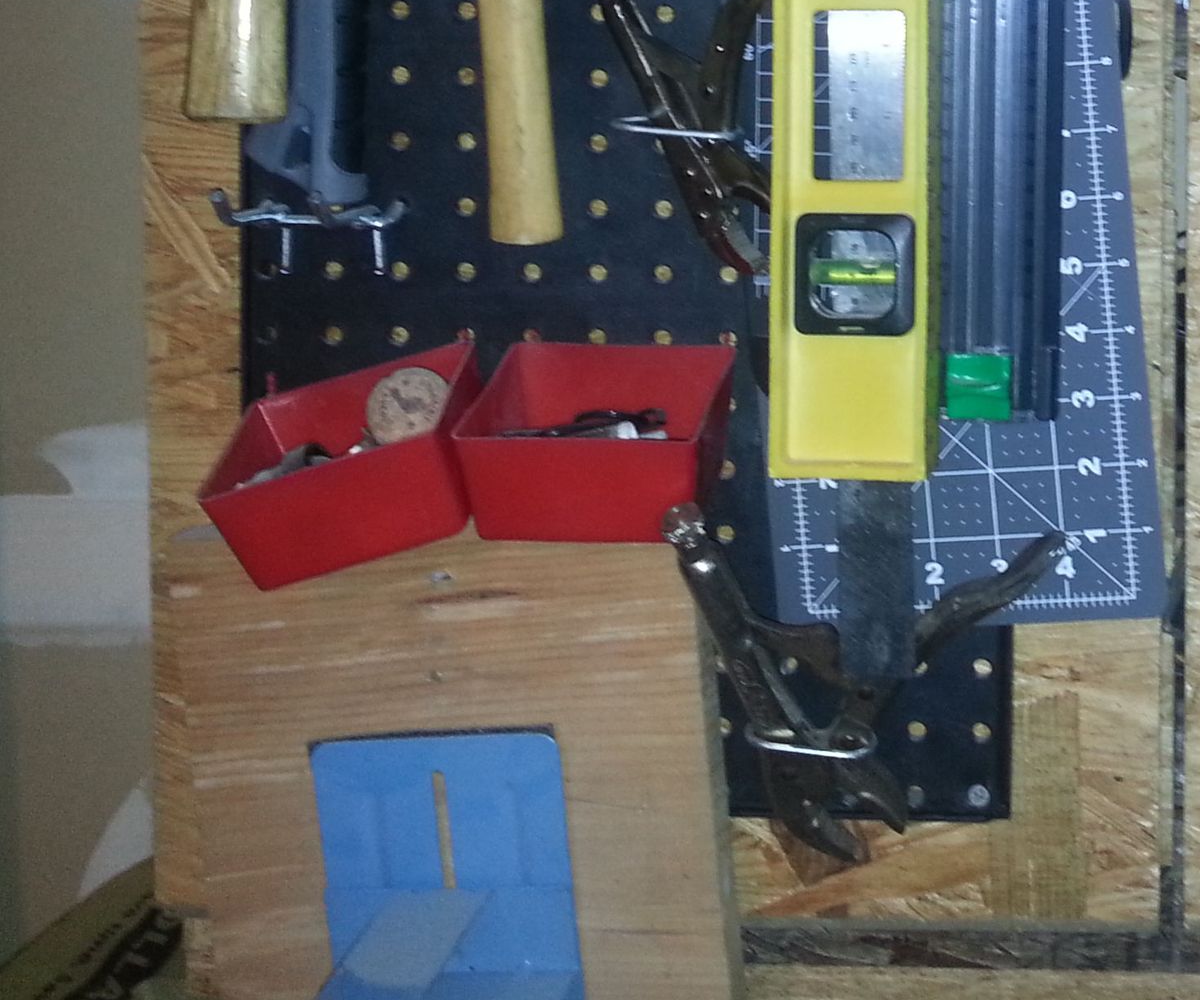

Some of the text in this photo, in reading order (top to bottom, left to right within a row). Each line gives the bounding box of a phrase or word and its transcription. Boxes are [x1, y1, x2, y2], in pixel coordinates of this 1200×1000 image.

[1059, 255, 1083, 275] 5
[1065, 322, 1089, 343] 4
[1071, 389, 1096, 408] 3
[1077, 456, 1102, 476] 2
[1083, 528, 1108, 543] 1
[924, 561, 945, 585] 2
[1055, 555, 1076, 579] 4
